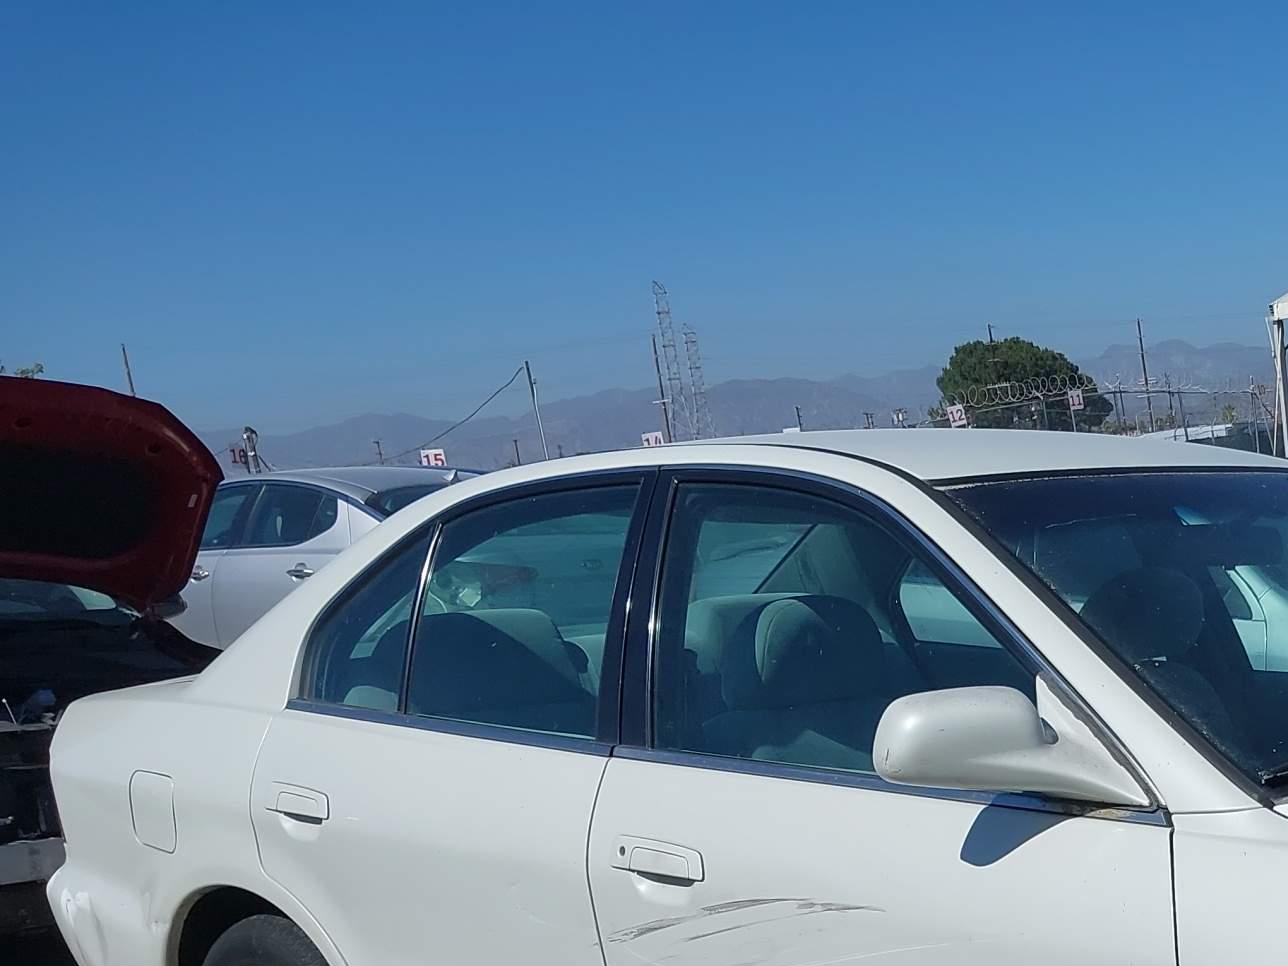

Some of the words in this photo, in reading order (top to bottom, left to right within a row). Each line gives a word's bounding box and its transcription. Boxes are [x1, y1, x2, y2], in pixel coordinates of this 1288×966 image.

[1070, 394, 1083, 406] 11
[949, 408, 965, 423] 12
[422, 453, 445, 466] 15
